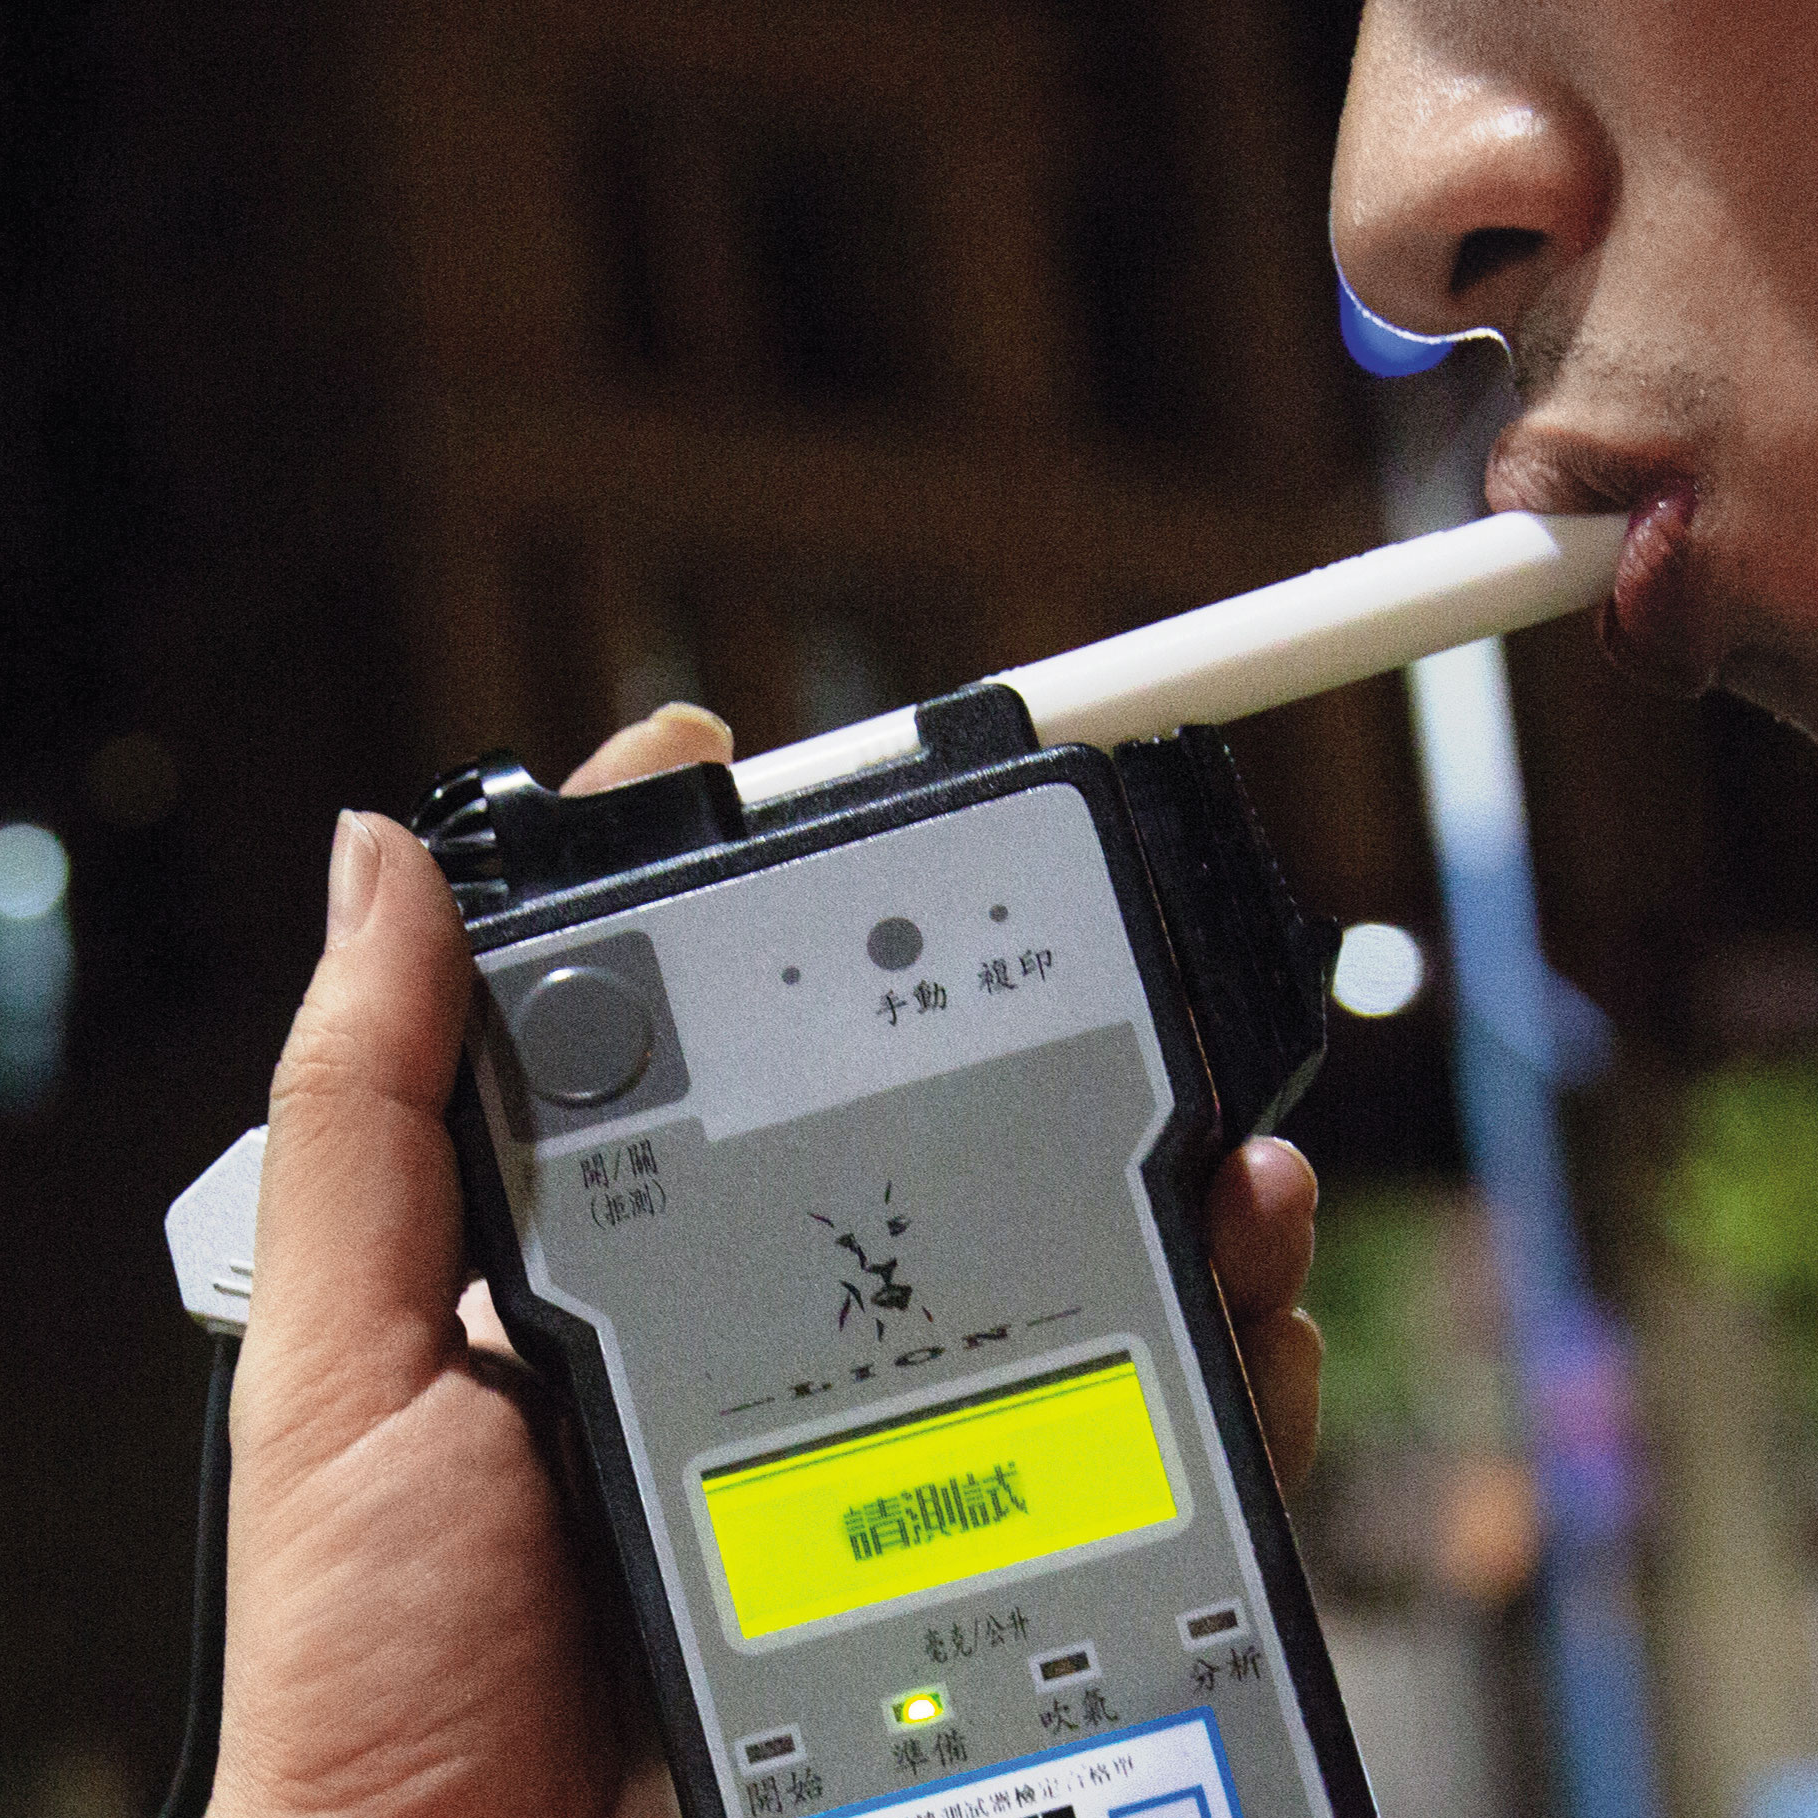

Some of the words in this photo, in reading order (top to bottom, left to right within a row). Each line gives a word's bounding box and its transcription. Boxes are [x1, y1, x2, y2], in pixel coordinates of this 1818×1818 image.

[876, 978, 947, 1027] 手動
[790, 1324, 1012, 1399] LION
[843, 1460, 1030, 1562] 請測試
[1189, 1646, 1264, 1695] 分析
[1040, 1687, 1119, 1732] 吹氣
[892, 1727, 969, 1775] 準備
[746, 1770, 824, 1818] 開始
